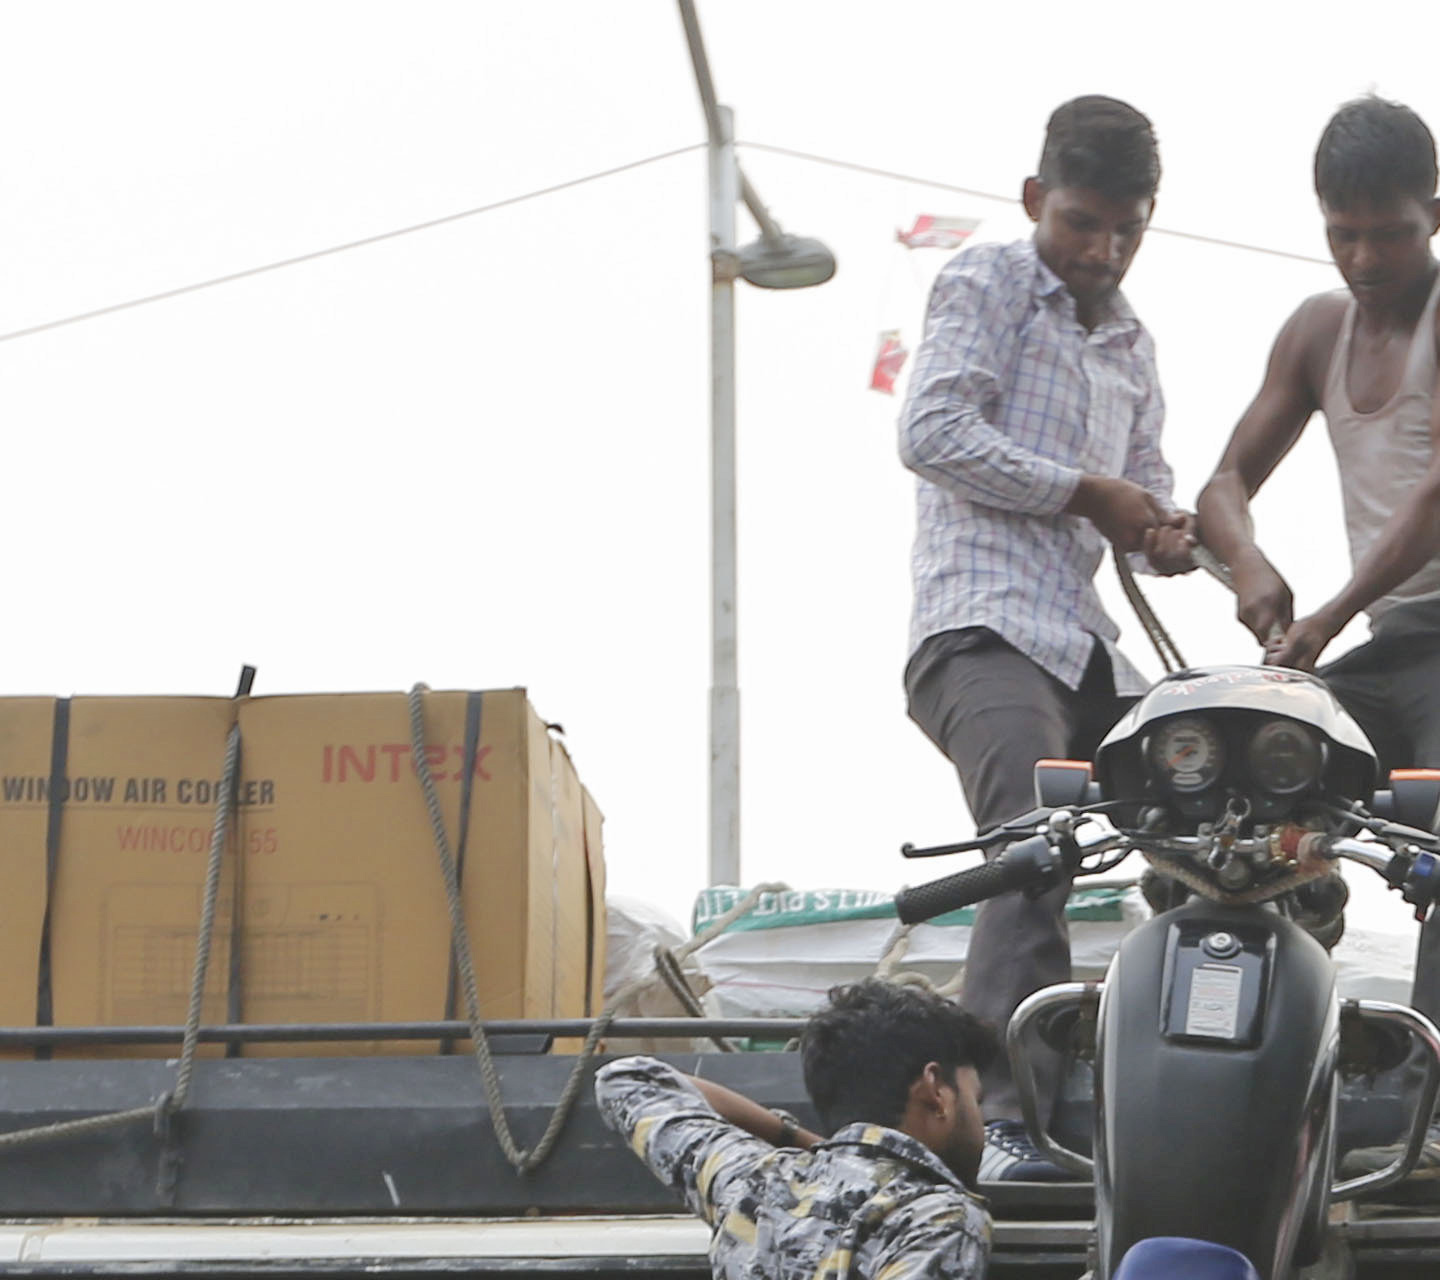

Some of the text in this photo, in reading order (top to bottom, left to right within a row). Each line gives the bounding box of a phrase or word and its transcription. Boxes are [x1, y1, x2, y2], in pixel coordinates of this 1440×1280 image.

[122, 777, 167, 804] AIR
[176, 778, 276, 806] COER
[116, 824, 279, 855] WINCOL 55
